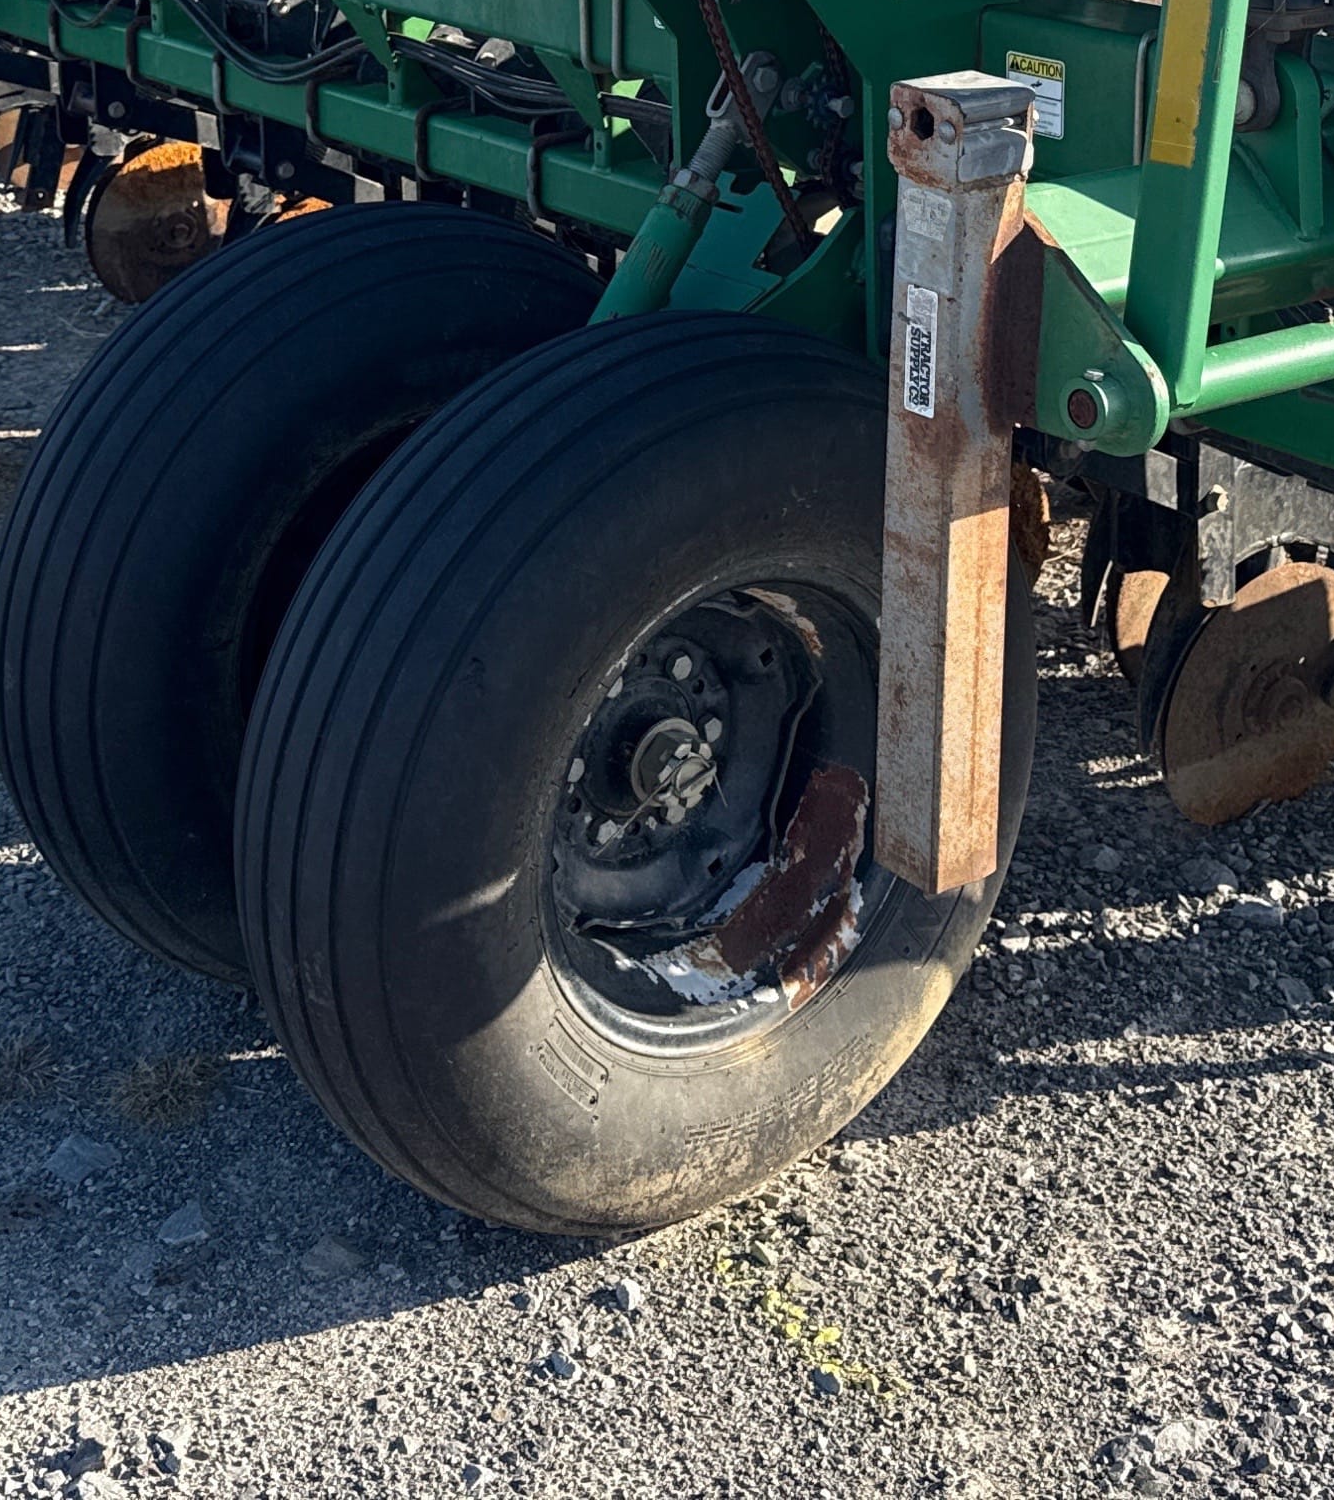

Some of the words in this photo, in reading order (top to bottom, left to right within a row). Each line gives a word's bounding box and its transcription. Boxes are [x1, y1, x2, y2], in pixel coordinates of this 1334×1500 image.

[1019, 58, 1063, 78] CAUTION
[909, 326, 921, 386] SUPPLY
[919, 331, 932, 407] TRACTOR
